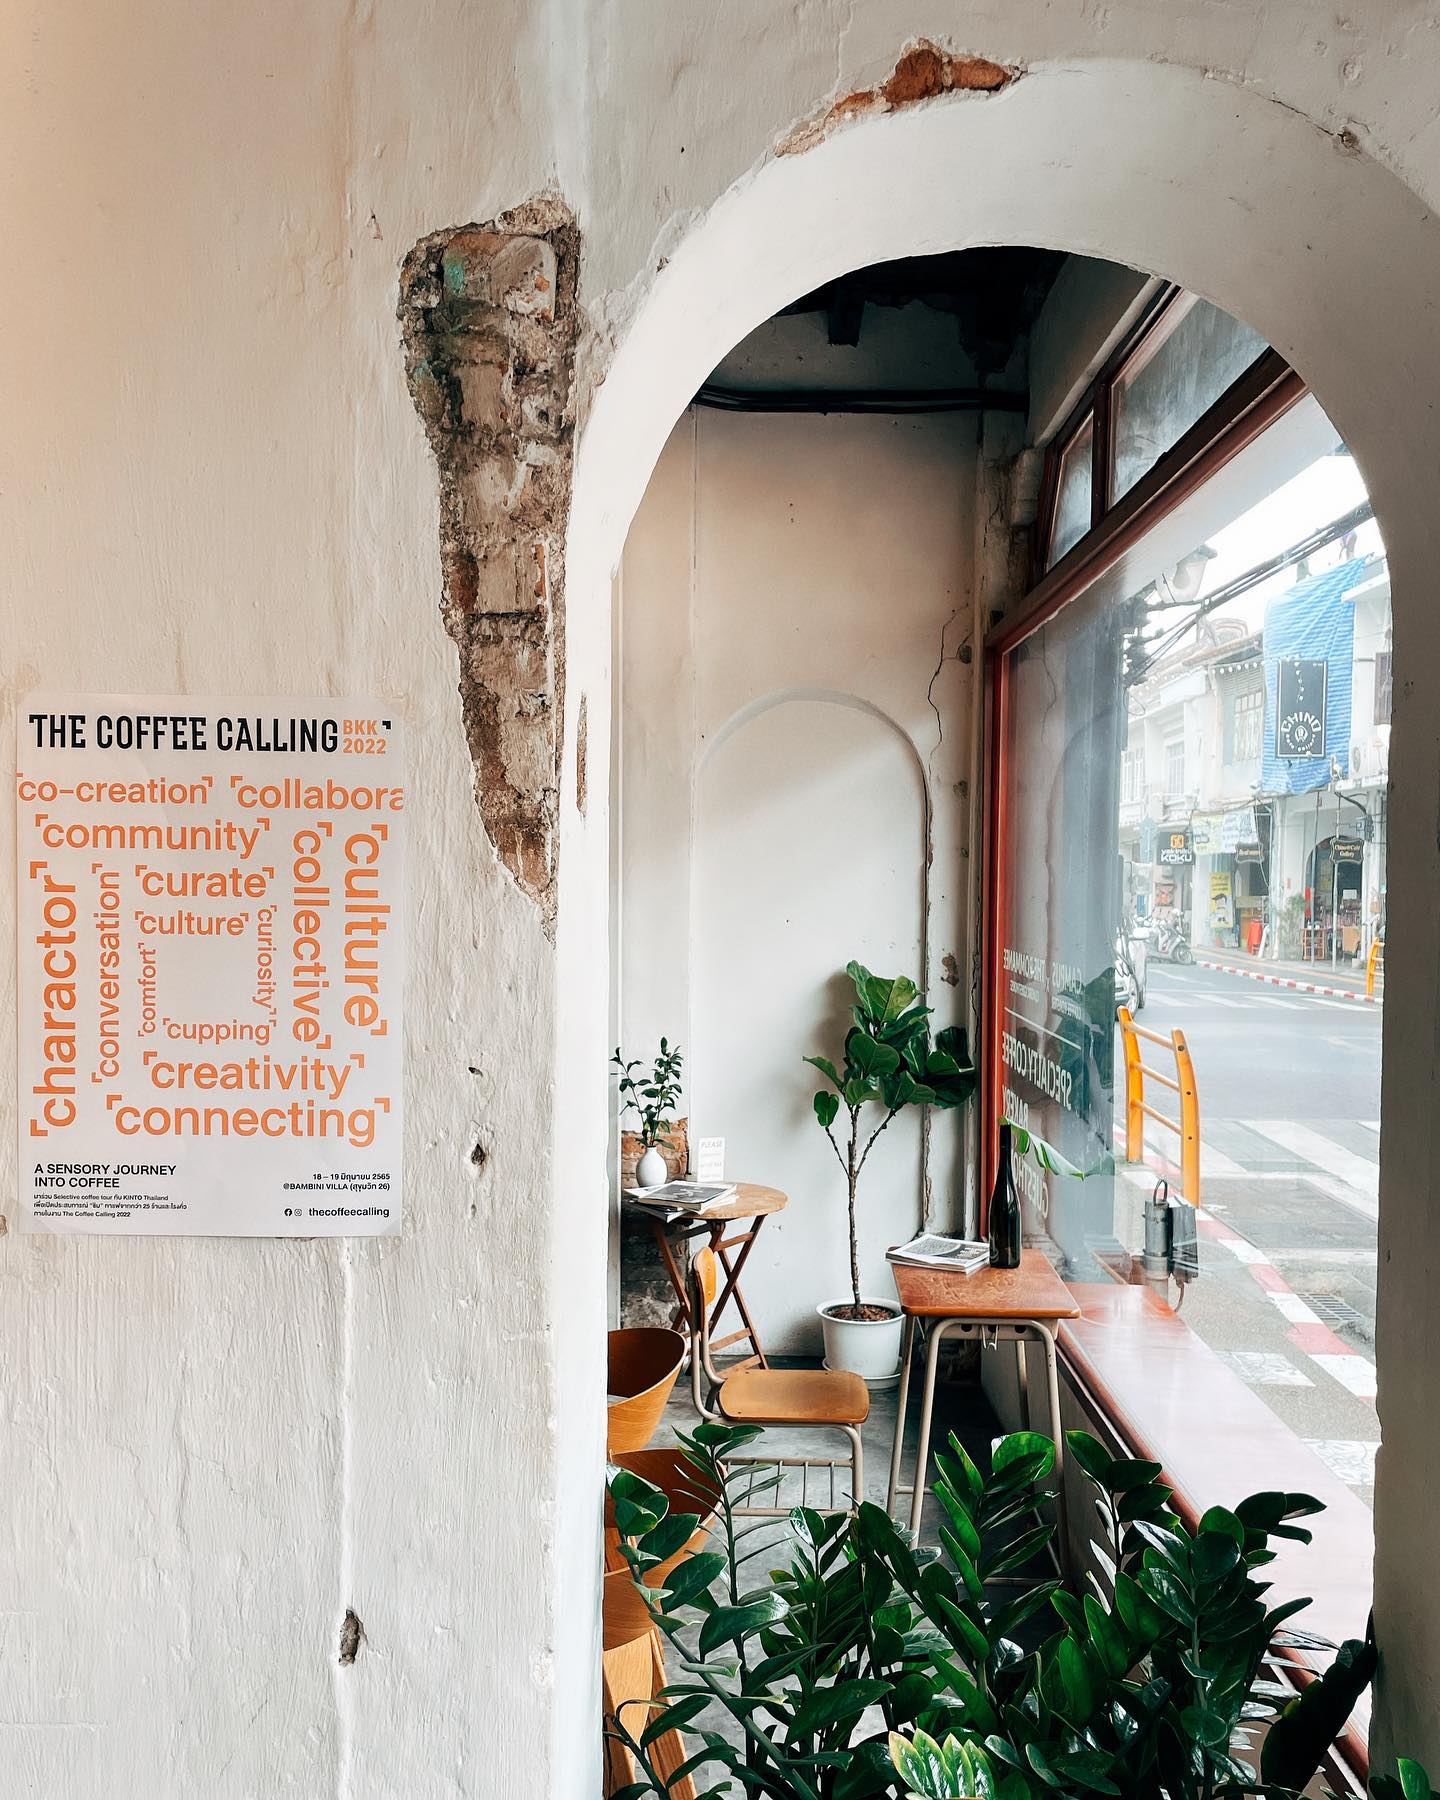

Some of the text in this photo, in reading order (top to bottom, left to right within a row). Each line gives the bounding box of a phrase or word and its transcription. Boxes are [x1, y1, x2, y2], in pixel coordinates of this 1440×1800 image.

[29, 714, 338, 753] THE COFFEE CALLING
[343, 719, 377, 735] BKK
[1281, 711, 1321, 732] CHINO
[342, 738, 386, 754] 2022
[18, 776, 208, 805] co-creation
[42, 819, 260, 860] community
[1160, 854, 1193, 863] KOKU
[143, 868, 267, 898] curate
[139, 910, 245, 936] culture
[293, 829, 330, 1042] collective
[344, 833, 391, 1027] culture
[253, 908, 277, 1009] curiosity
[94, 871, 121, 1077] conversation
[32, 875, 77, 1128] charactor
[138, 948, 157, 1034] comfort
[166, 1019, 271, 1045] cupping
[151, 1056, 351, 1100] creativity
[115, 1099, 375, 1148] connecting
[34, 1164, 177, 1176] A SENSORY JOURNEY
[34, 1177, 120, 1188] INTO COFFEE
[378, 1183, 391, 1191] 26)
[95, 1211, 115, 1219] Calling
[308, 1207, 390, 1218] thecoffeecalling
